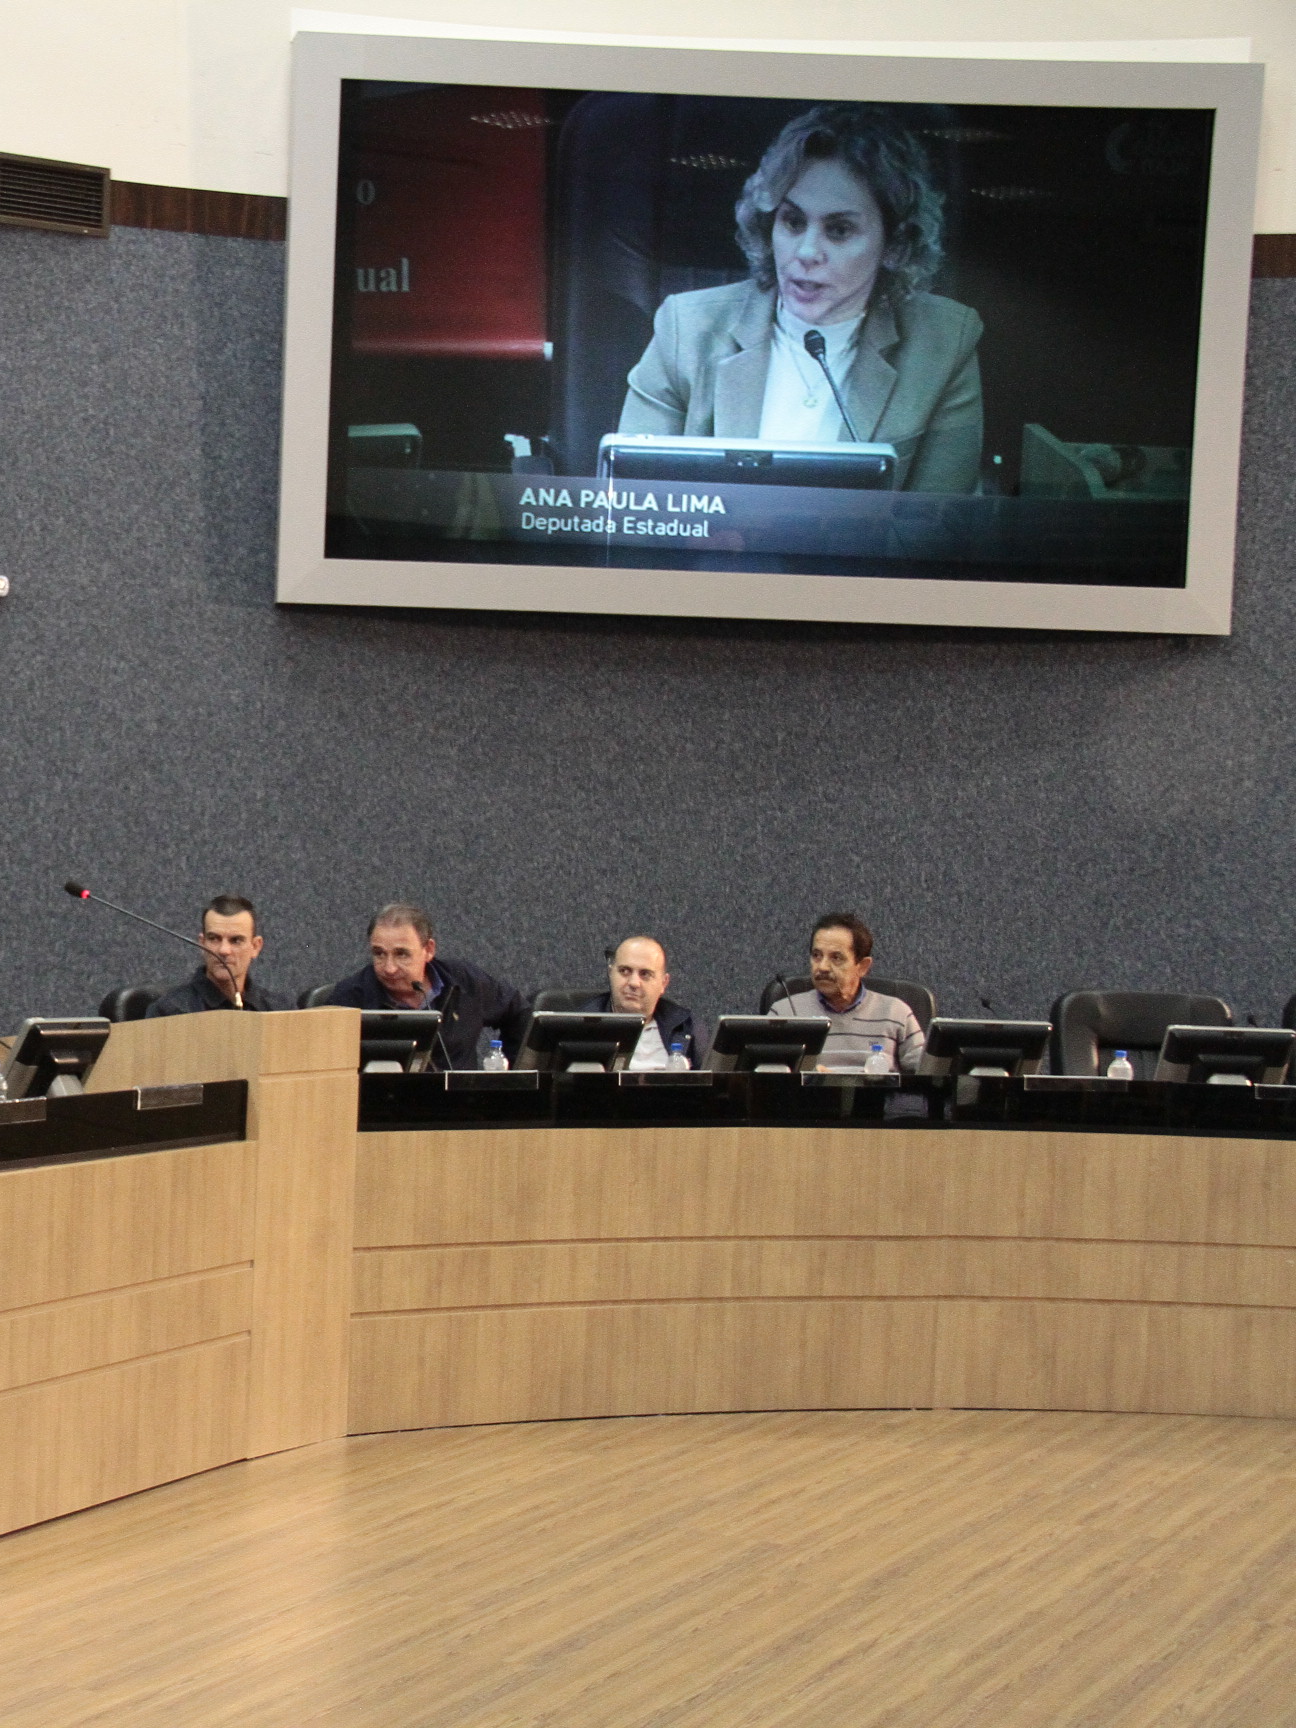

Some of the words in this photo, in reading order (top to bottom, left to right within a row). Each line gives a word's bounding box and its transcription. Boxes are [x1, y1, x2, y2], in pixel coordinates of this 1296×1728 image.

[356, 256, 410, 292] ual
[519, 487, 573, 508] ANA
[580, 489, 659, 512] PAULA
[667, 493, 726, 514] LIMA
[521, 512, 616, 534] Deputada
[623, 516, 709, 538] Estadual
